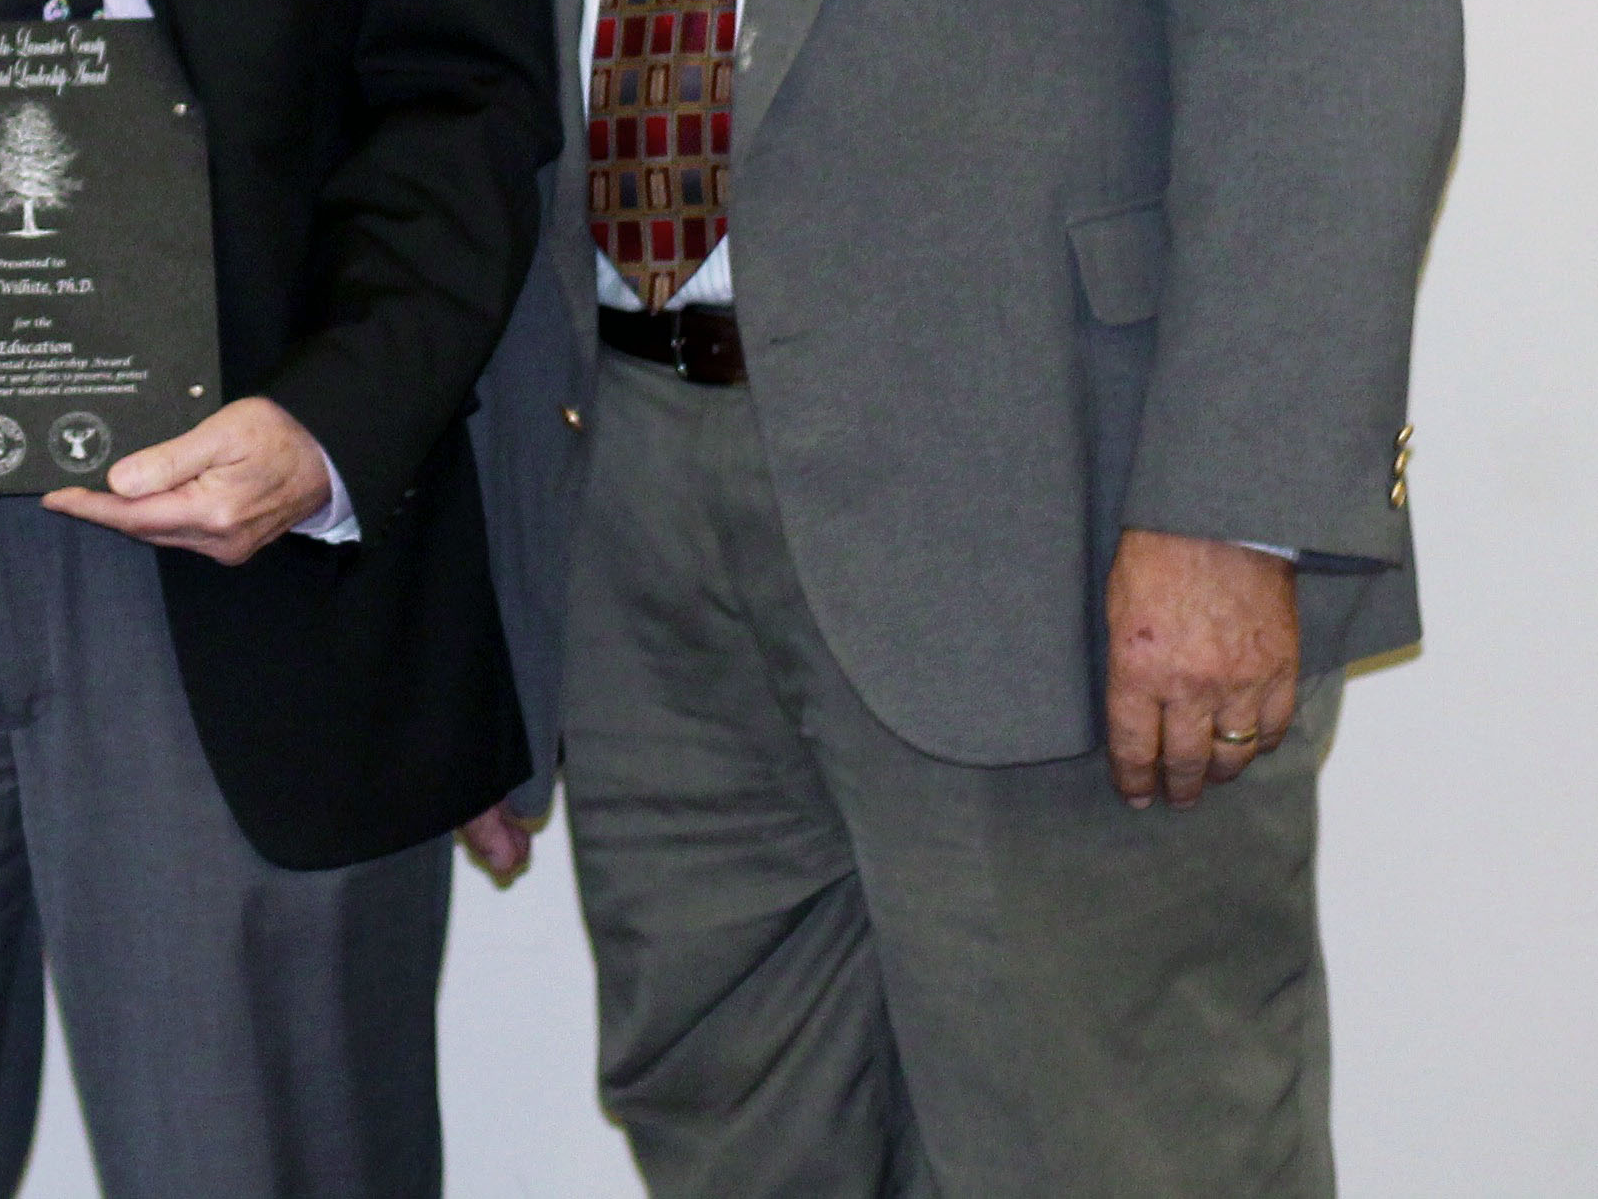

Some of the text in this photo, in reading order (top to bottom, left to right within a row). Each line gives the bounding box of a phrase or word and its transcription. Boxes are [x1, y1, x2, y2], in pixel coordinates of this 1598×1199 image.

[56, 276, 94, 294] Ph.D.
[12, 316, 52, 331] for the
[27, 357, 88, 370] Leadership
[91, 355, 133, 368] Award
[17, 384, 62, 395] natural
